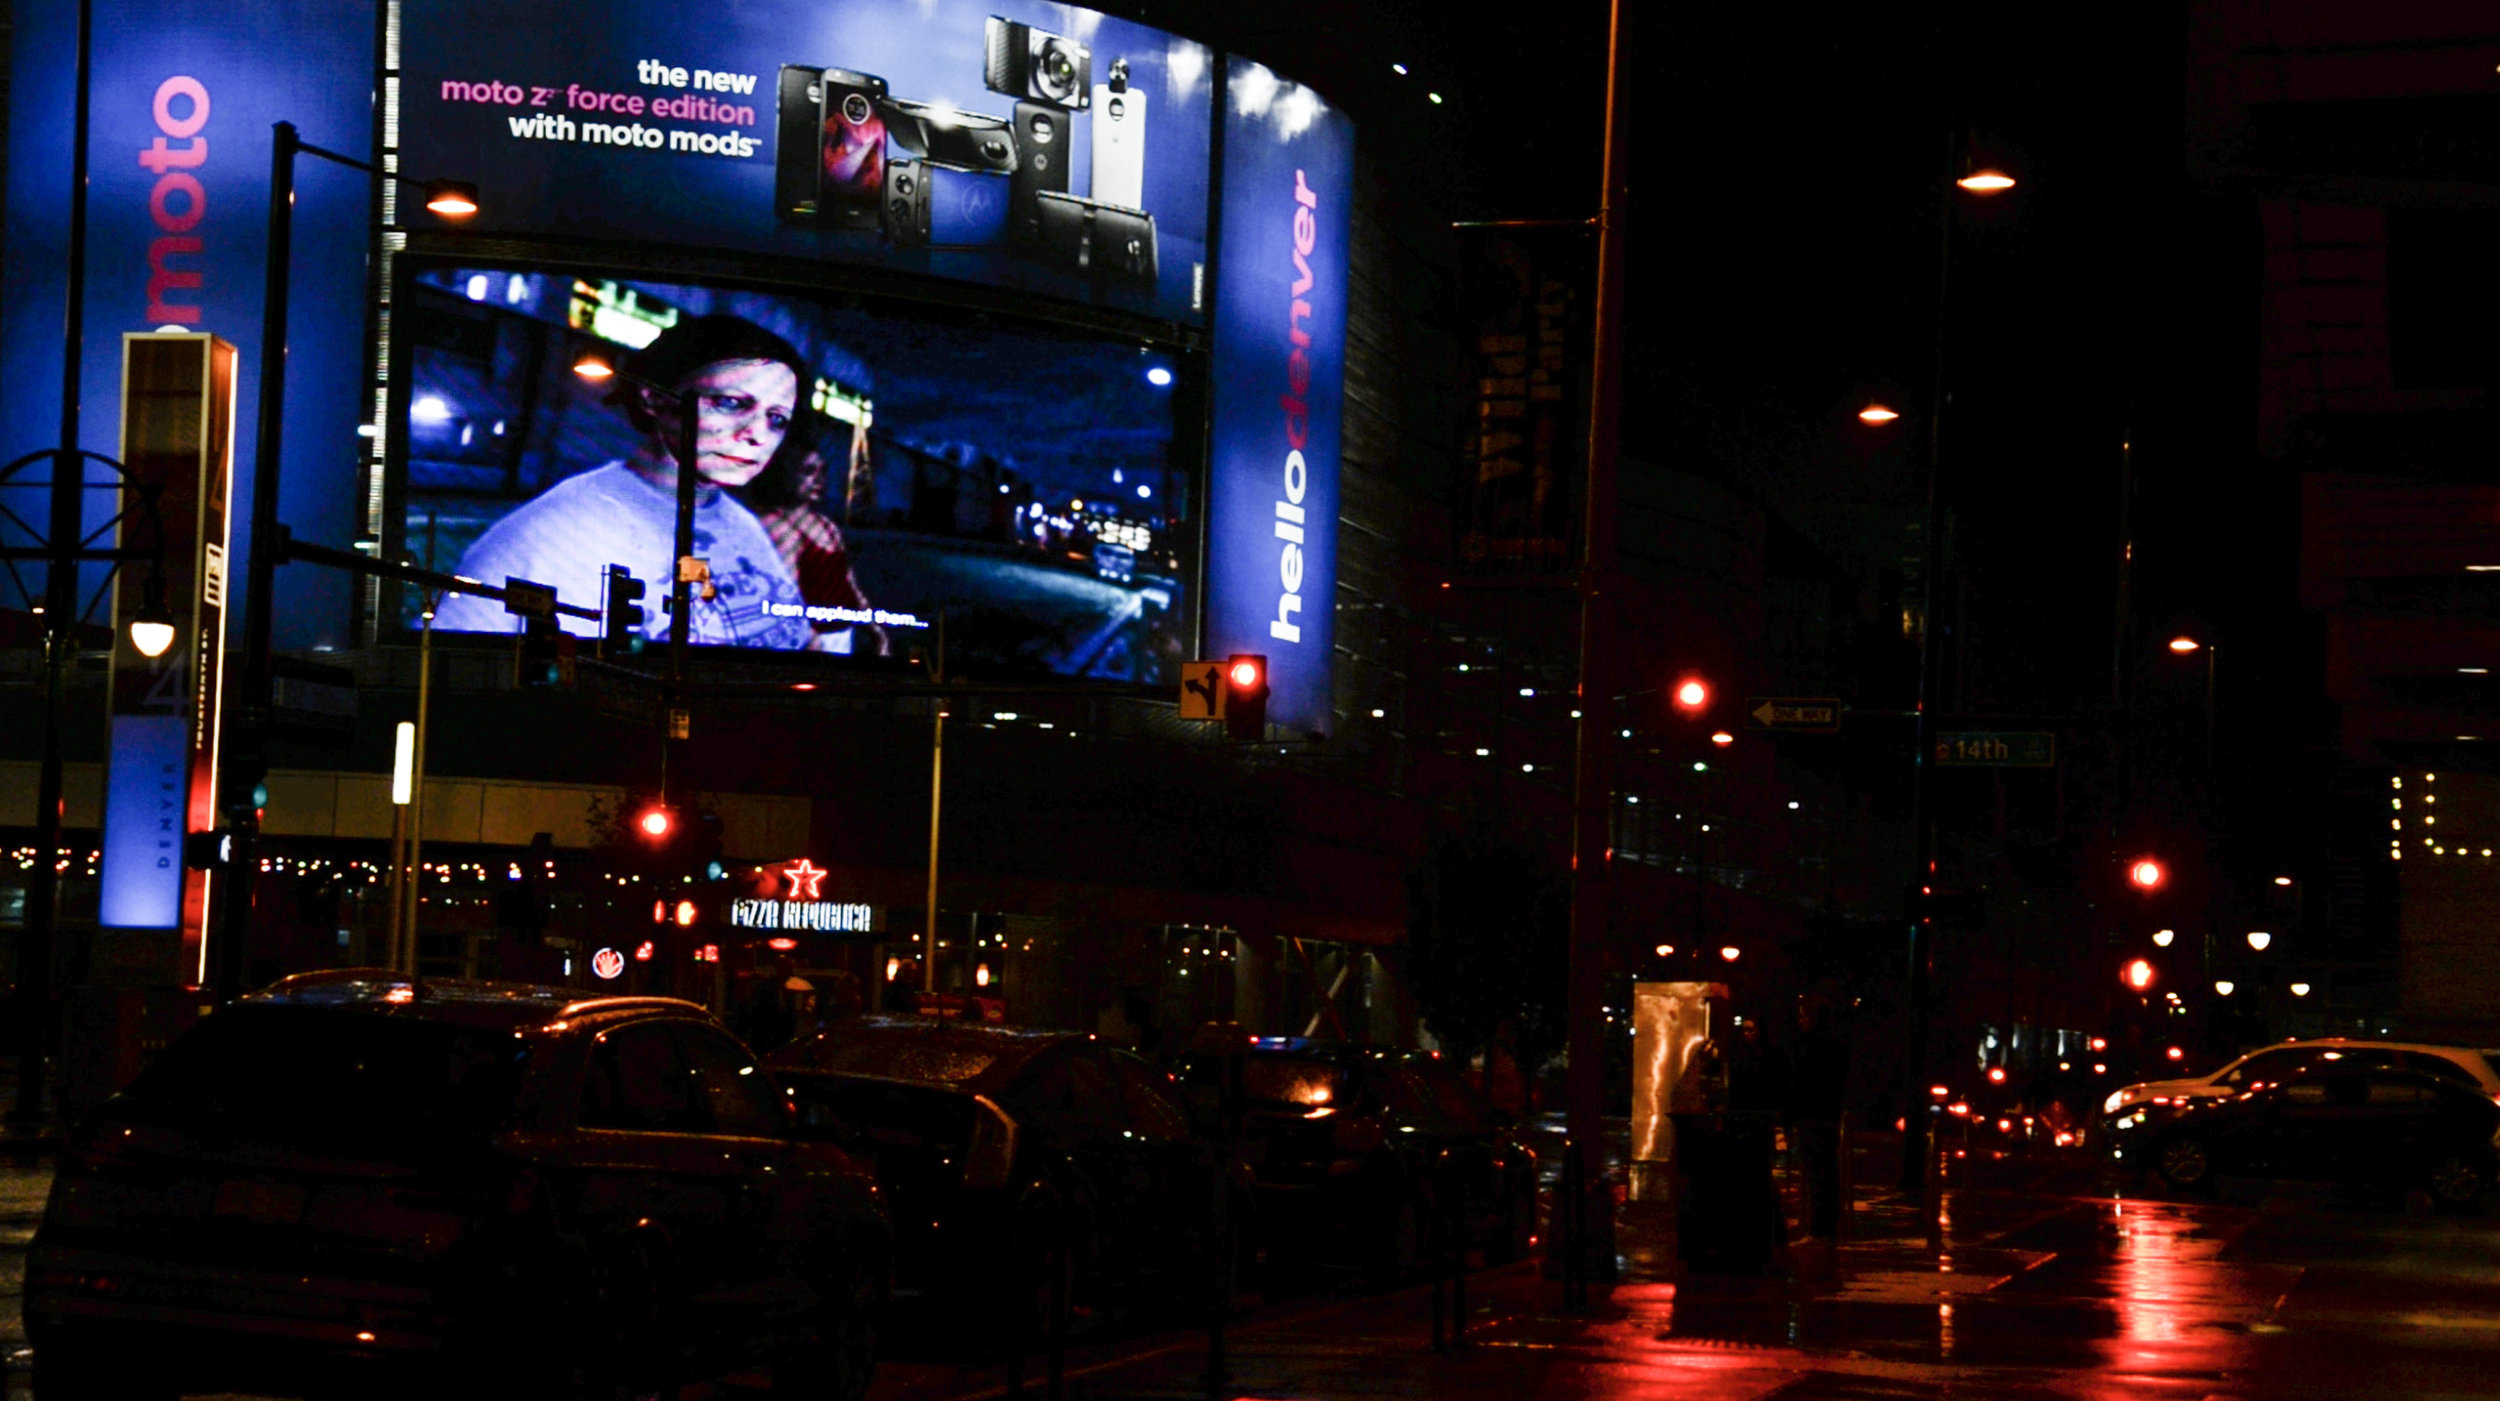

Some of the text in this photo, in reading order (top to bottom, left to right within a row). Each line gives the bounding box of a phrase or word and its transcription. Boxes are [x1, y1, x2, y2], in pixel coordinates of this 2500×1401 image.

[637, 59, 757, 95] the new
[441, 80, 524, 105] moto
[566, 84, 645, 116] force
[651, 94, 755, 126] edition
[508, 113, 577, 141] with
[581, 121, 665, 149] moto
[138, 74, 211, 324] moto
[762, 599, 769, 615] I
[770, 602, 804, 617] can
[805, 605, 873, 622] applaud
[1956, 738, 2008, 761] 14th
